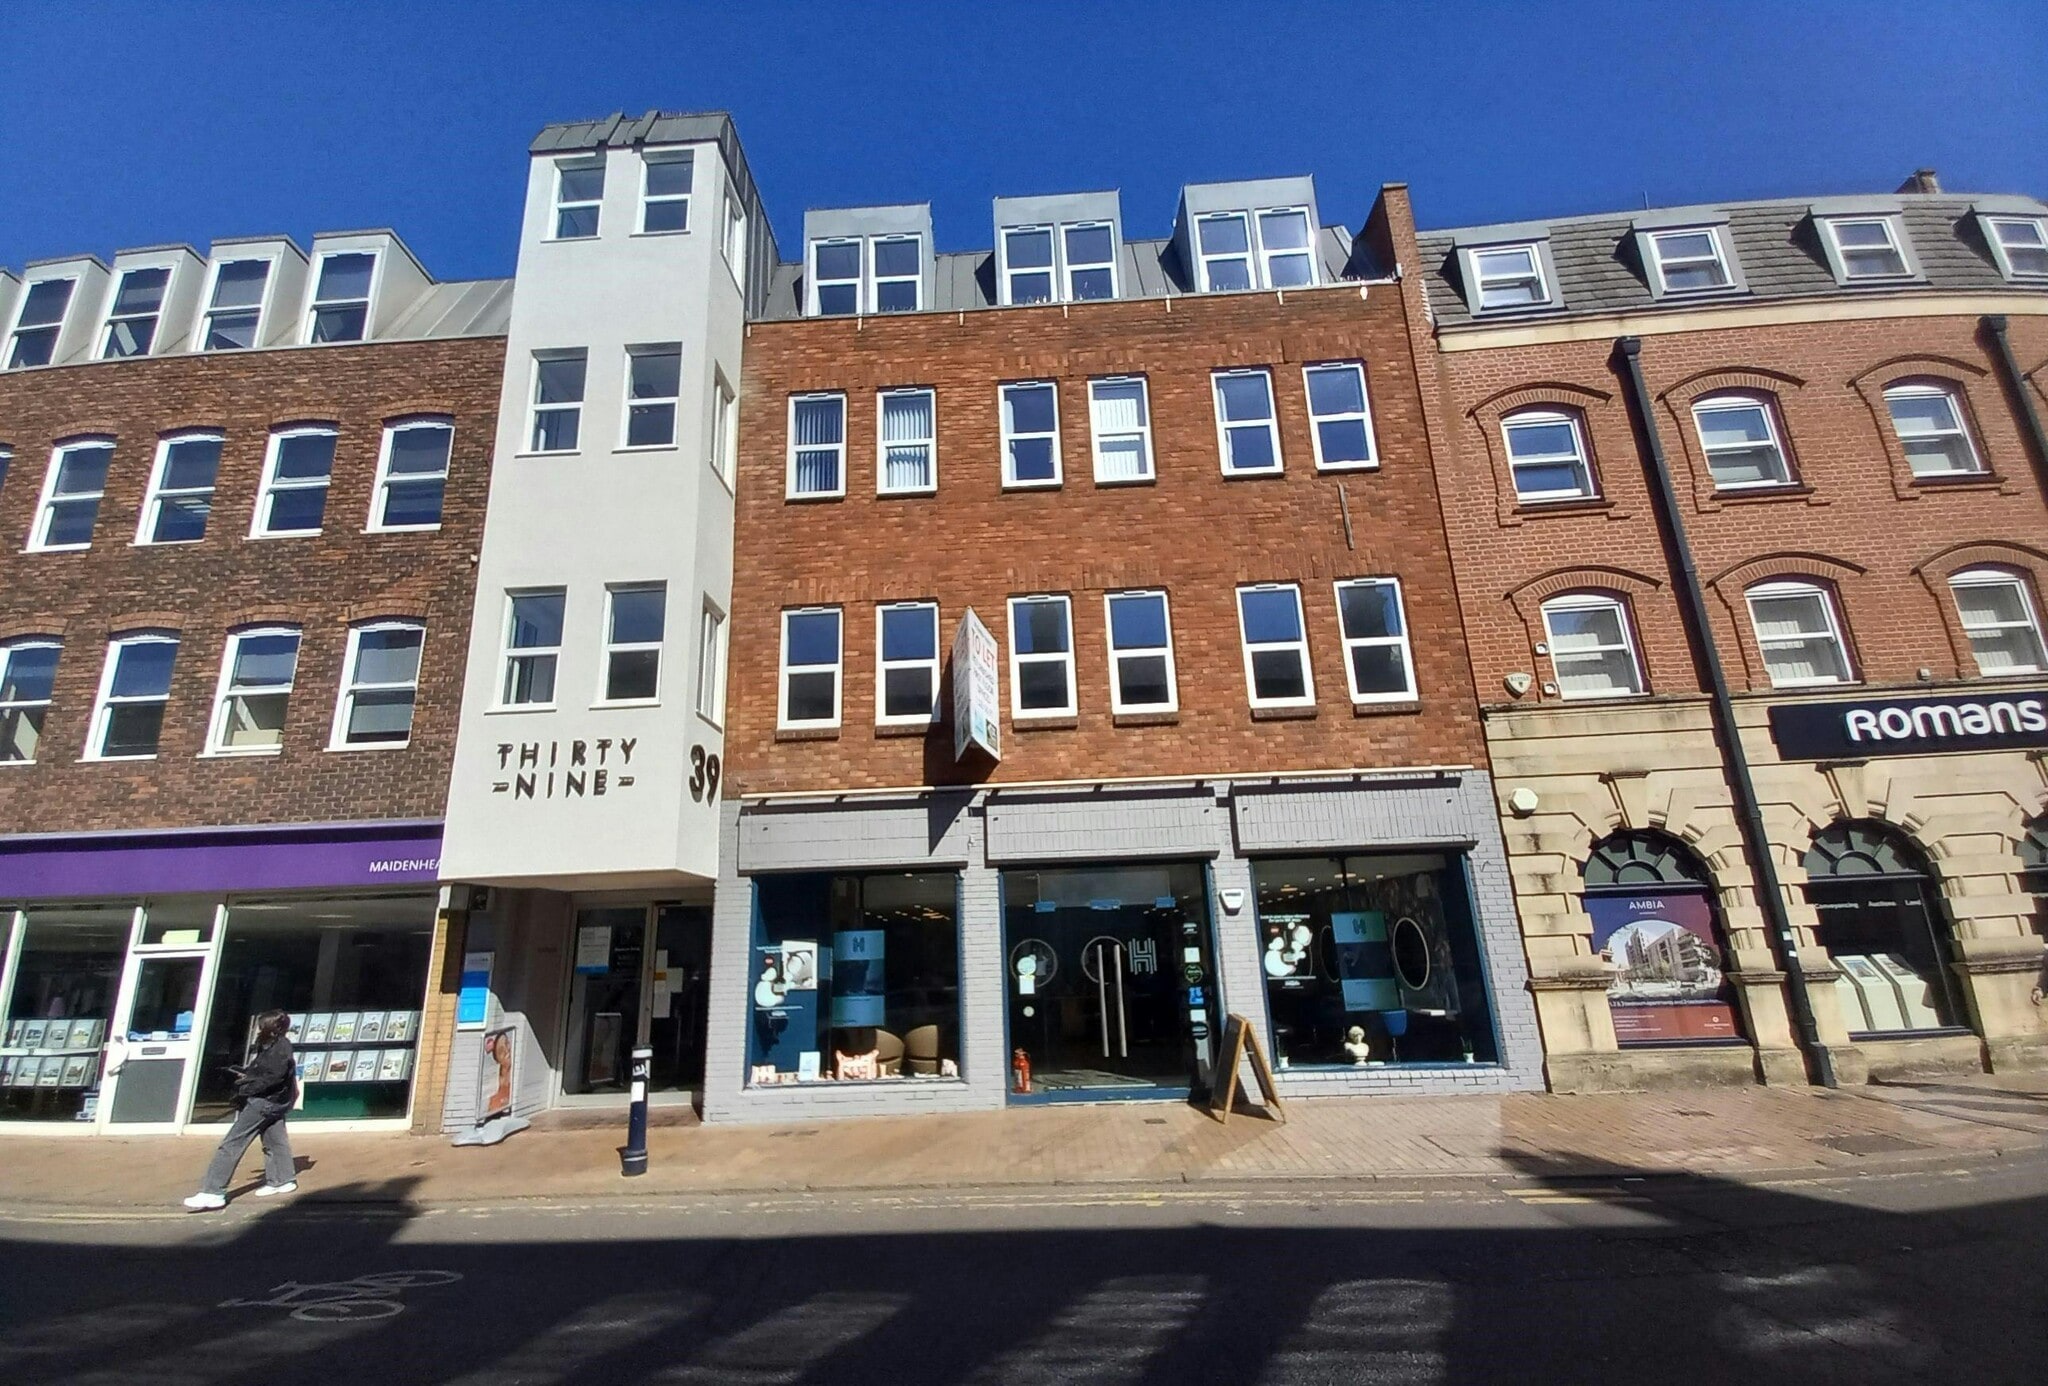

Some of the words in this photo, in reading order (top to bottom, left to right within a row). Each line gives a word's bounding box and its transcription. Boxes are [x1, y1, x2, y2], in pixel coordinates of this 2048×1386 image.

[497, 738, 637, 770] THIRTY
[689, 744, 721, 808] 39
[1629, 901, 1665, 910] AMBIA
